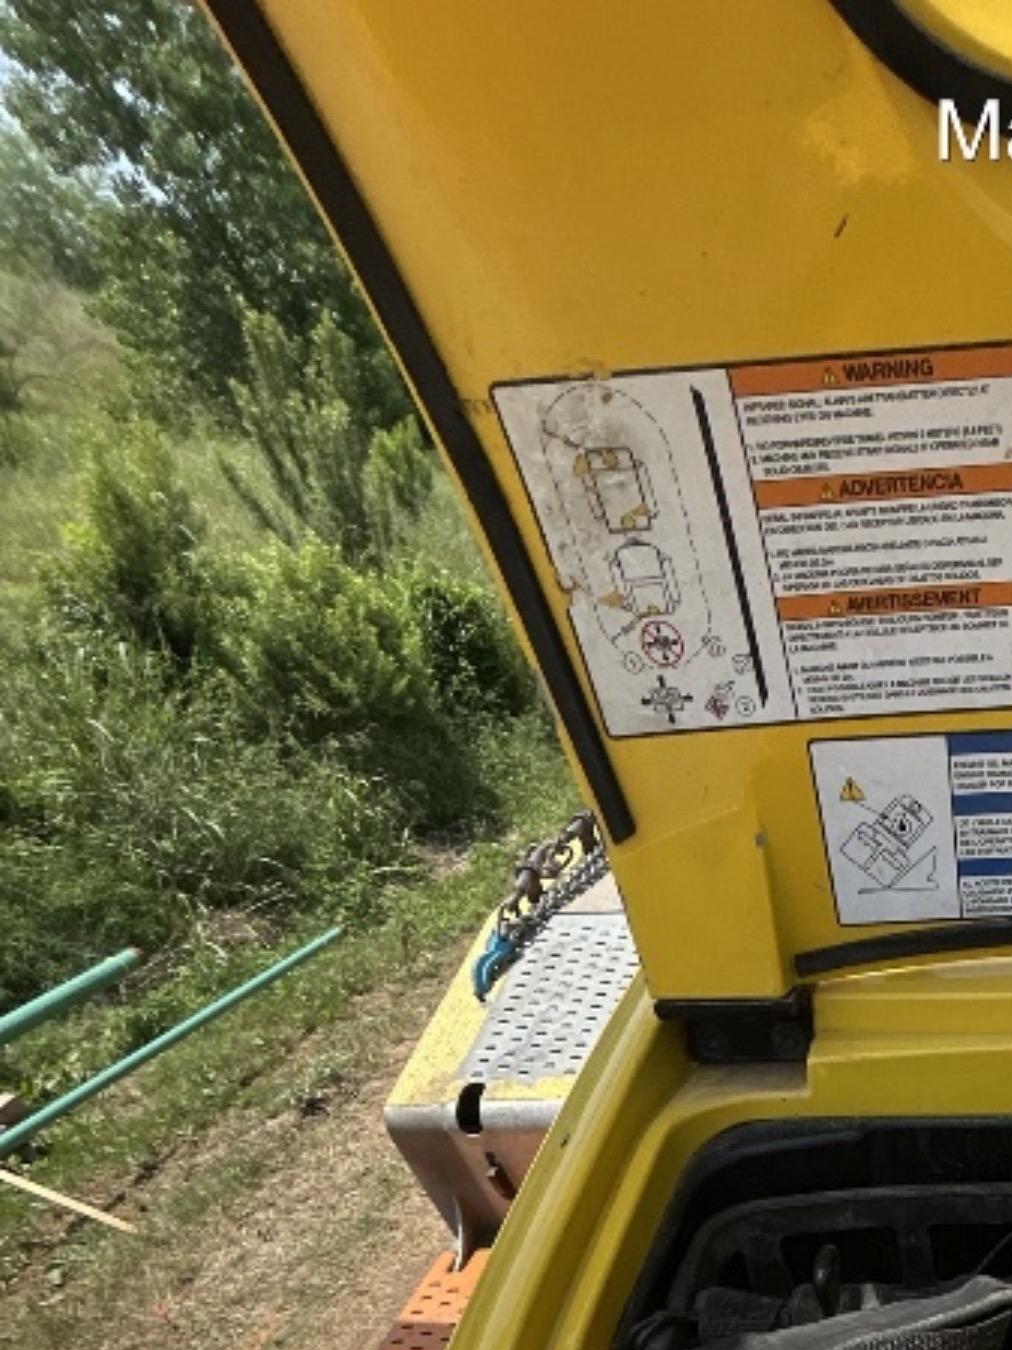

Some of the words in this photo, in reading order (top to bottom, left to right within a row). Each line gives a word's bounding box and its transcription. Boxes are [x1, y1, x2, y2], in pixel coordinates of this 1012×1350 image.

[842, 358, 934, 381] WARNING
[839, 472, 964, 497] ADVERTENCIA
[847, 587, 981, 612] AVERTISSEMENT
